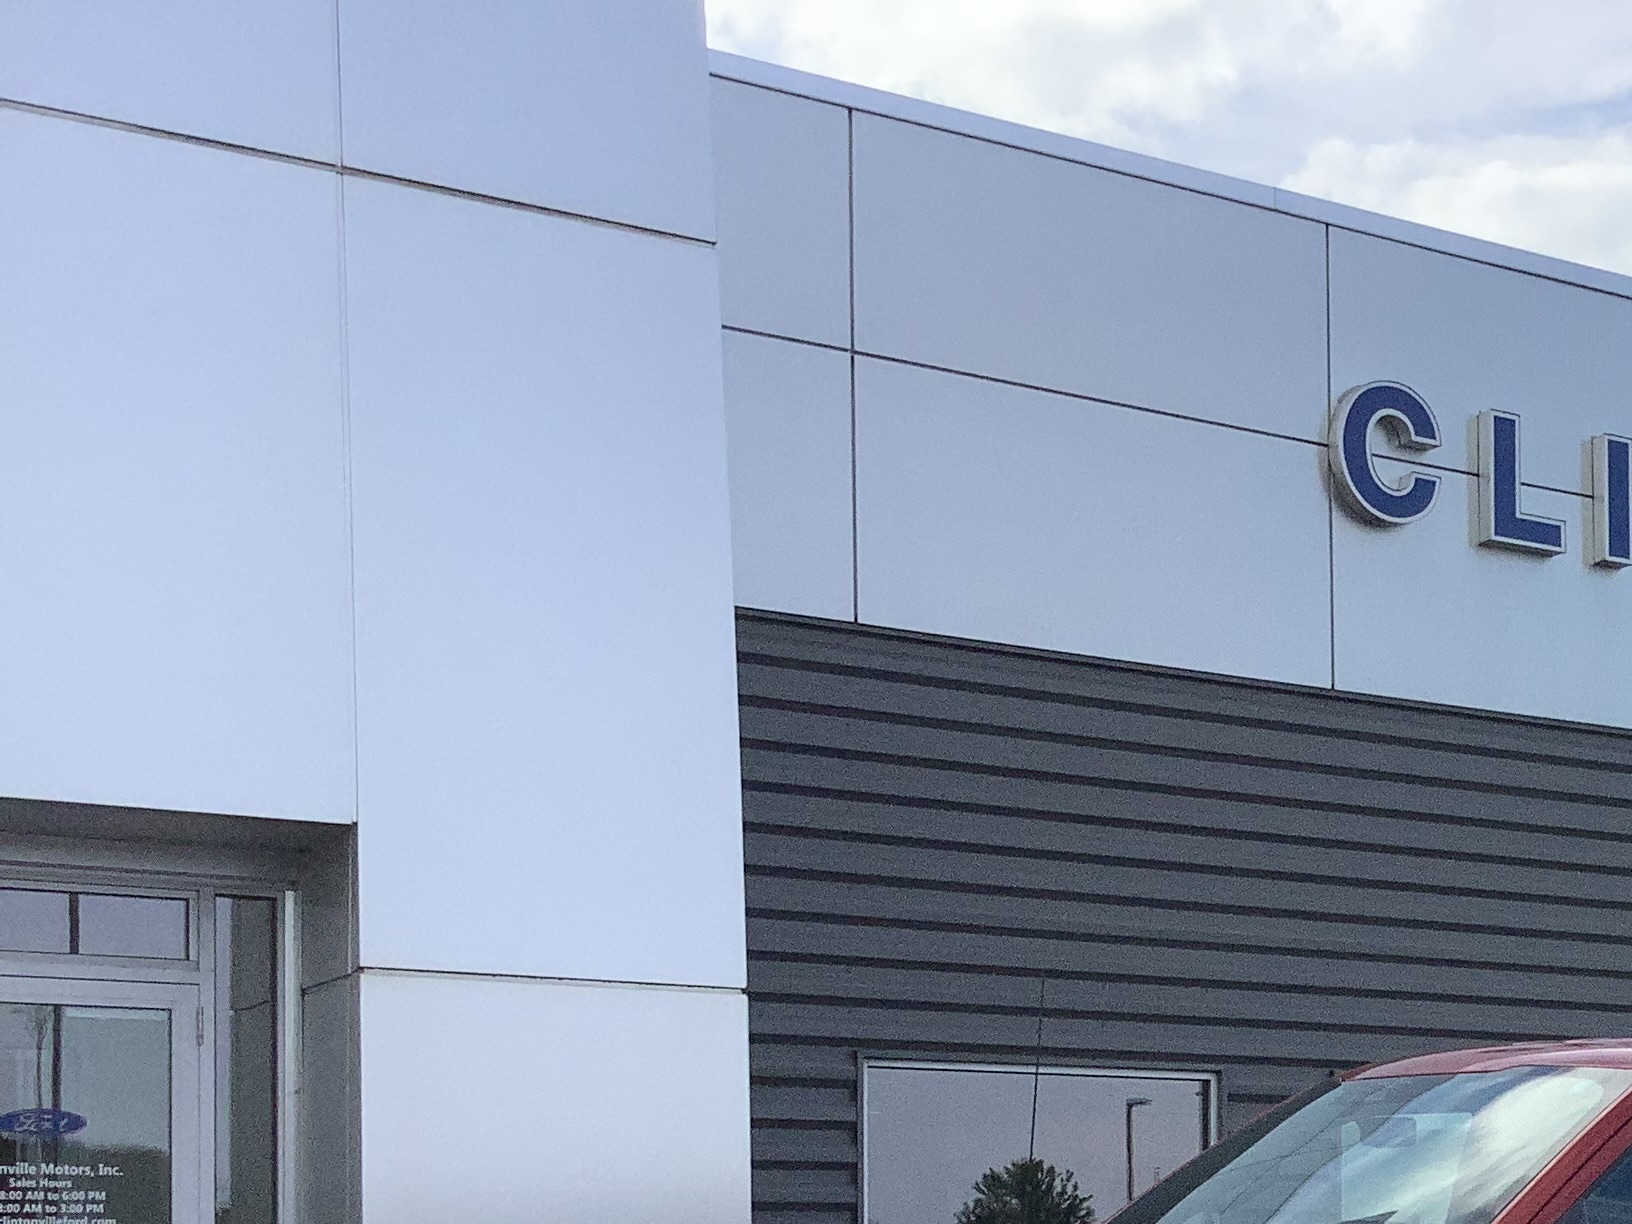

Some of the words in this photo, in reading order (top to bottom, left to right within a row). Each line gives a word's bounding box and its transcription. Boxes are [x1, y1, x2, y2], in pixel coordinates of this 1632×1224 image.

[40, 1163, 95, 1177] Motors,
[98, 1163, 124, 1176] Inc.
[9, 1178, 37, 1188] Sales
[40, 1178, 73, 1188] Hours
[25, 1191, 45, 1200] AM
[47, 1191, 60, 1200] to
[87, 1191, 107, 1200] PM
[23, 1204, 42, 1213] AM
[45, 1204, 57, 1213] to
[86, 1204, 104, 1213] PM
